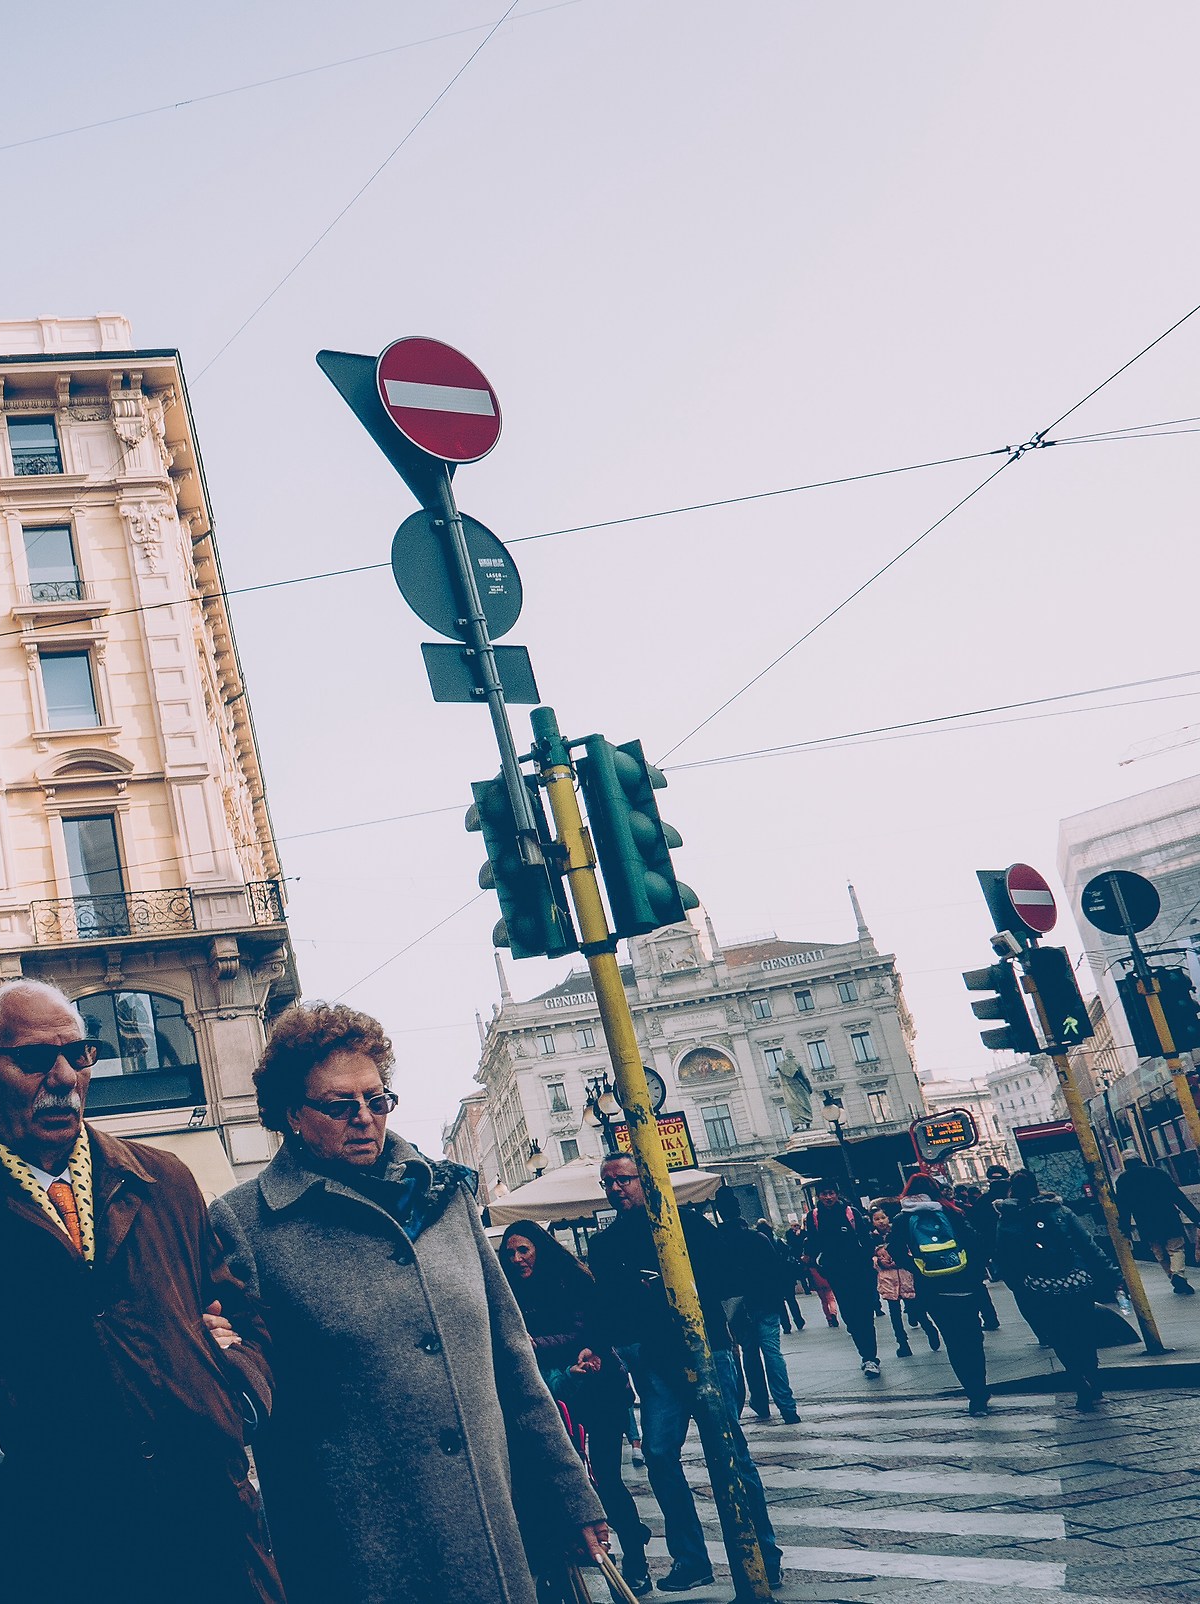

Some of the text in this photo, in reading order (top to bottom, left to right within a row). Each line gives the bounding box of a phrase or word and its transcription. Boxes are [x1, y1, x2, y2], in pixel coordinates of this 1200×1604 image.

[761, 949, 825, 971] GENERALI
[657, 1117, 682, 1127] Mega
[617, 1123, 684, 1143] SE HOP
[661, 1137, 684, 1151] IKA
